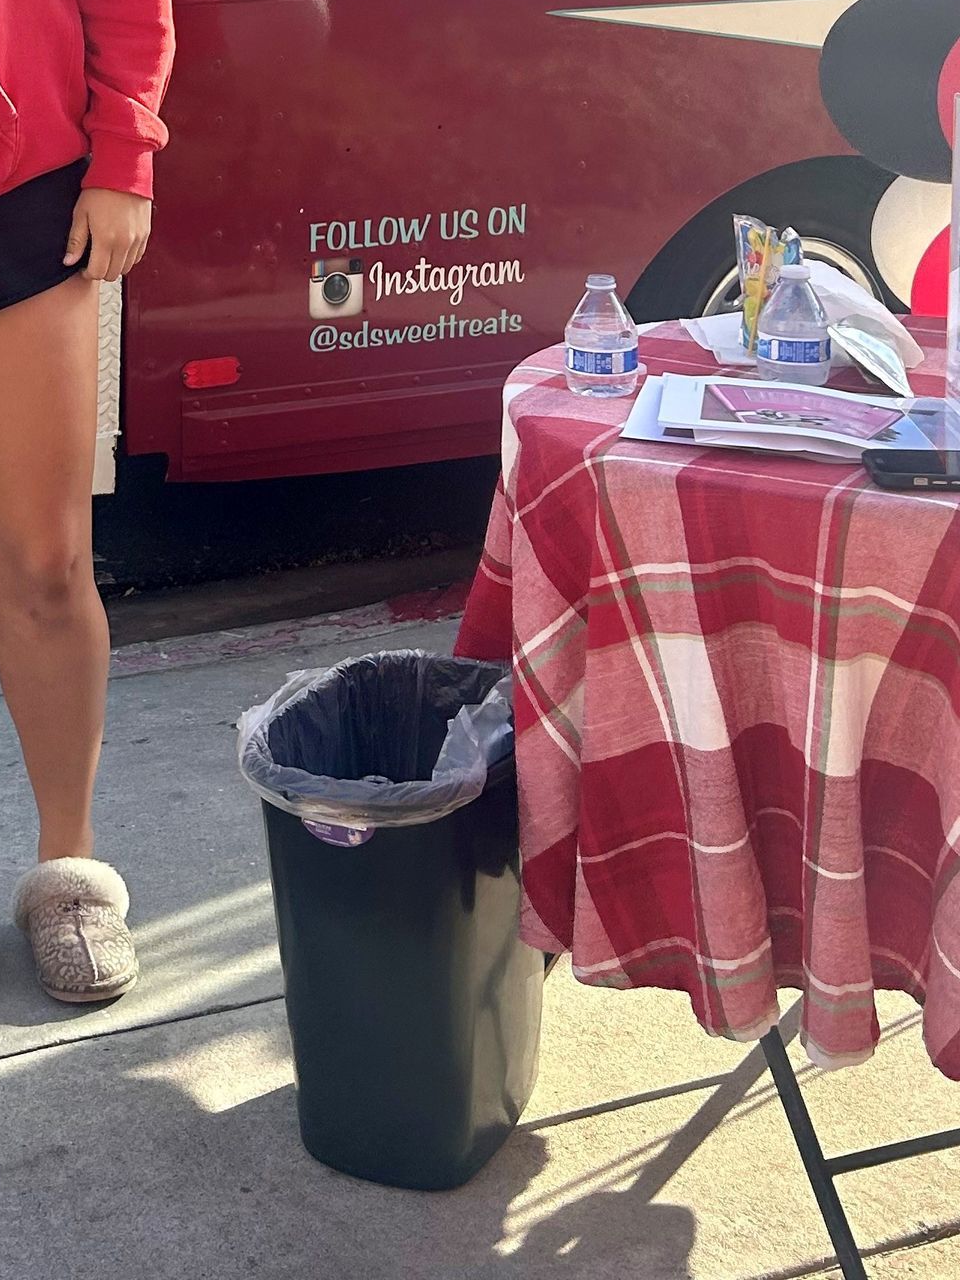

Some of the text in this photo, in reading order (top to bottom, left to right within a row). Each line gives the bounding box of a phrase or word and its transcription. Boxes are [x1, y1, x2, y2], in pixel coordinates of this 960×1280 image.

[309, 203, 527, 252] FOLLOW US ON
[368, 257, 525, 306] Instagram
[309, 308, 523, 352] @sdsweettreats
